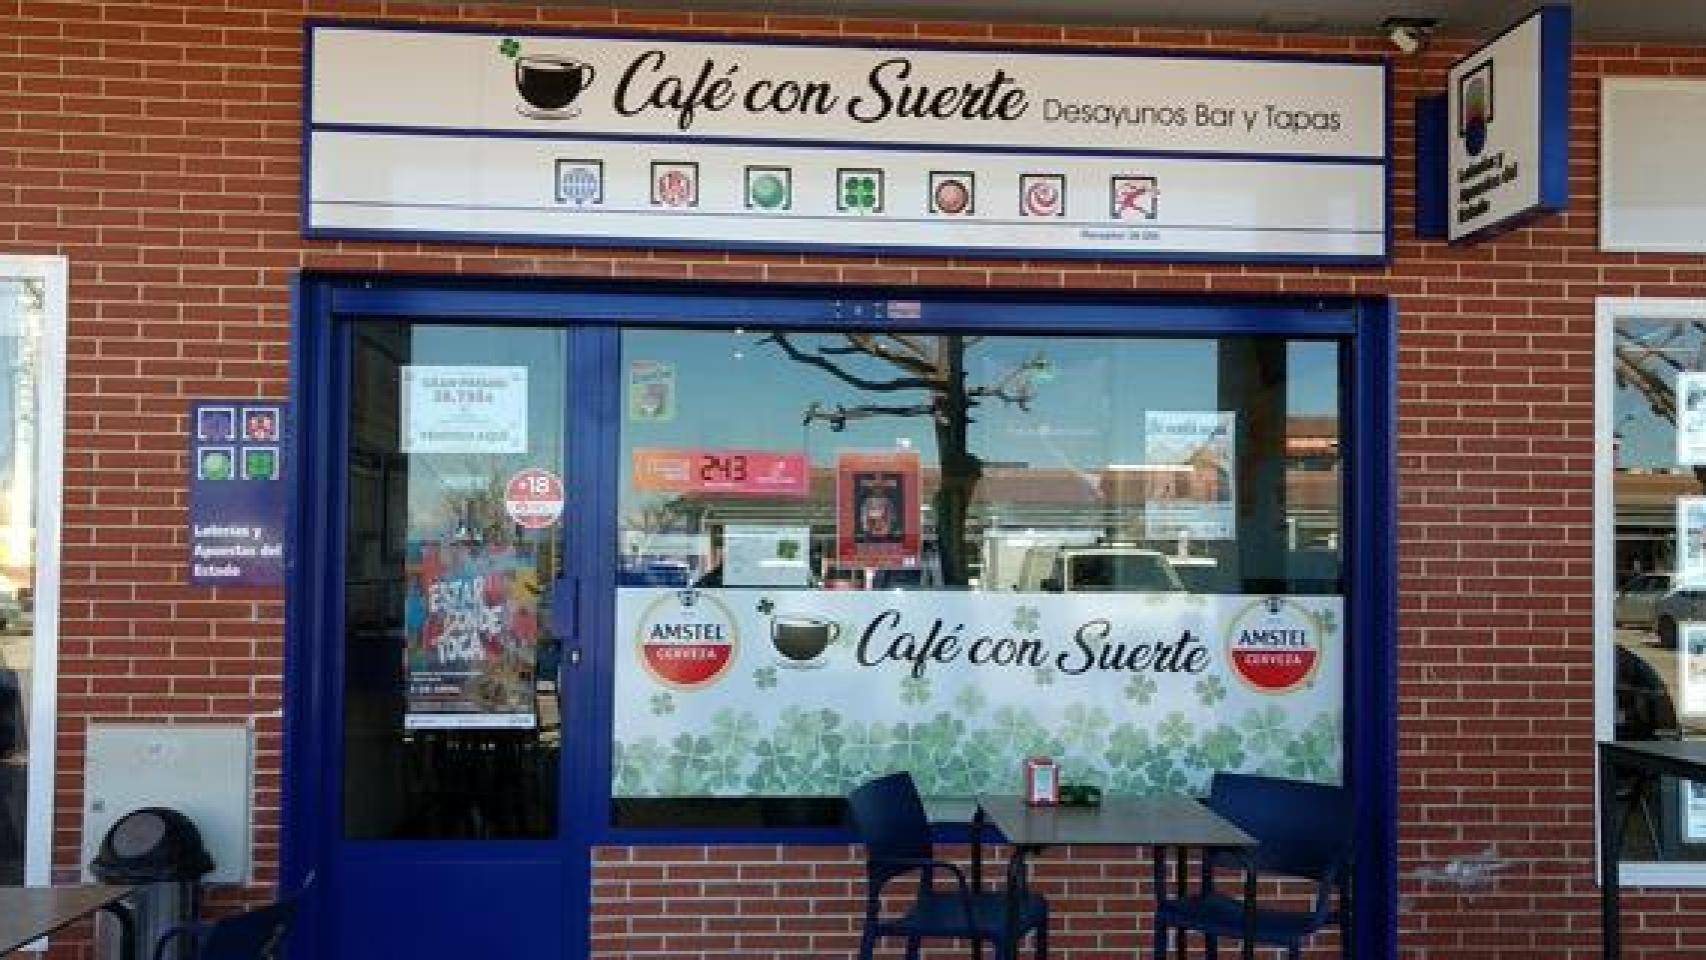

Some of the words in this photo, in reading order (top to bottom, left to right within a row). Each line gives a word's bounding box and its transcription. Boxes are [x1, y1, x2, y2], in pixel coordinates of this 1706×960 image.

[614, 50, 738, 130] Café
[744, 77, 840, 115] con
[846, 57, 1028, 124] Suerte
[1043, 98, 1187, 127] Desayunos
[1195, 103, 1235, 127] Bar
[1243, 109, 1257, 131] y
[1265, 105, 1341, 132] Tapas
[700, 455, 748, 482] 243
[649, 622, 726, 641] AMSTEL
[857, 609, 964, 679] Café
[968, 634, 1048, 667] con
[1055, 618, 1211, 676] Suerte
[1238, 629, 1312, 646] AMSTEL
